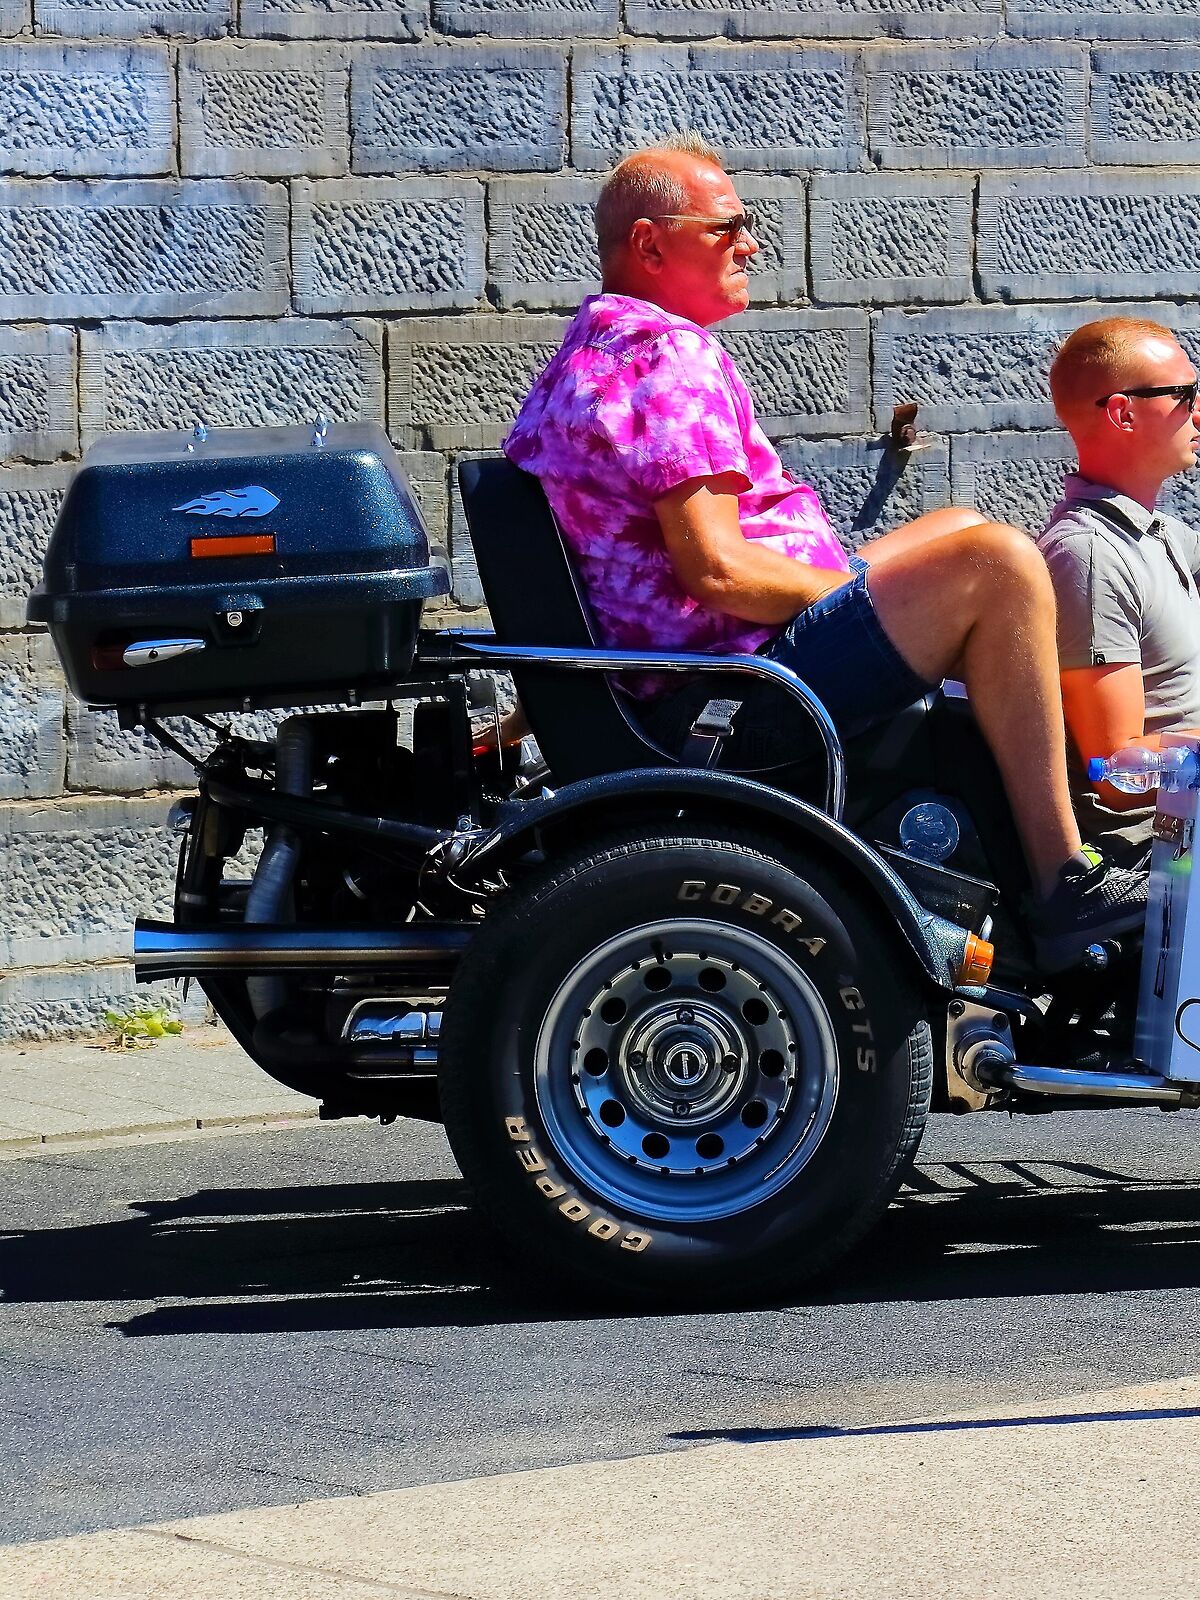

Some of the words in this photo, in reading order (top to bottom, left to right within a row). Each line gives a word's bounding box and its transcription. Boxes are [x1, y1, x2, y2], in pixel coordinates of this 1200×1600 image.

[677, 879, 828, 958] COBRA
[839, 986, 877, 1073] GTS
[504, 1115, 653, 1254] COOPER
